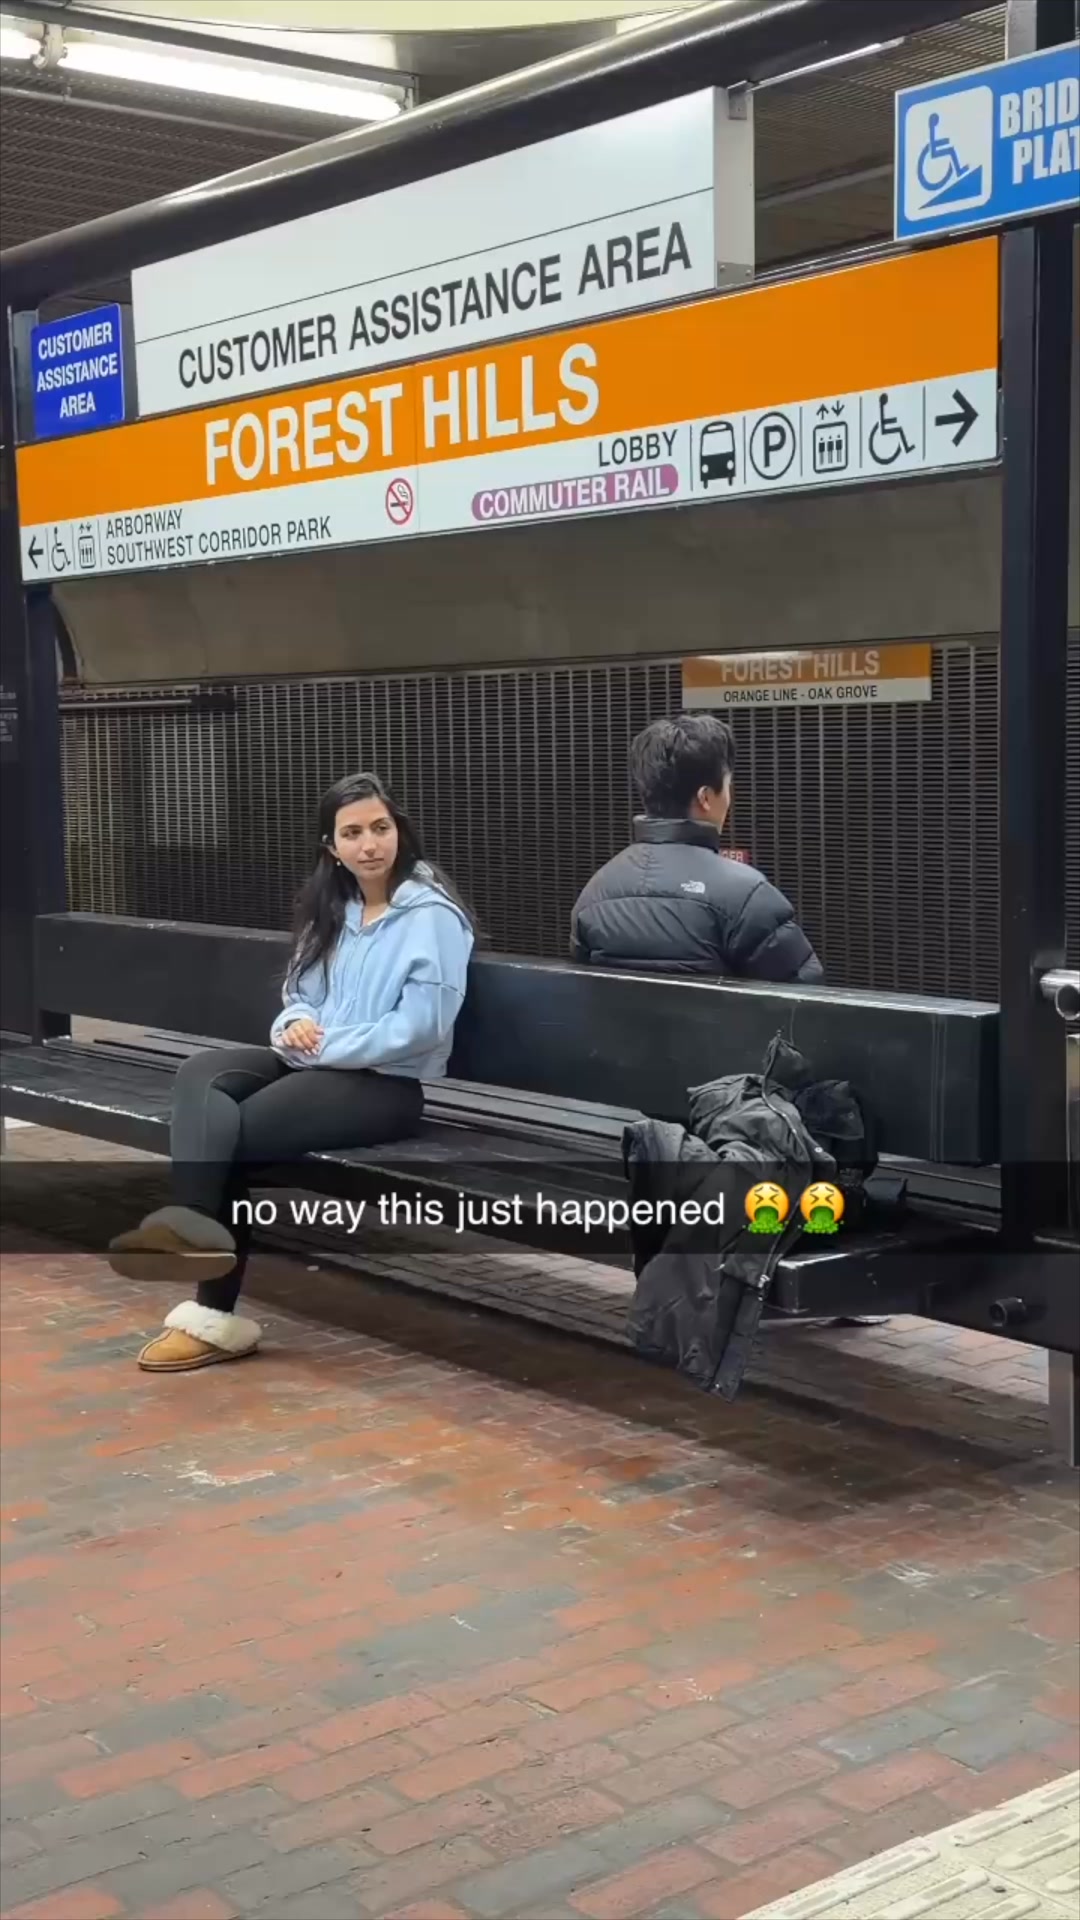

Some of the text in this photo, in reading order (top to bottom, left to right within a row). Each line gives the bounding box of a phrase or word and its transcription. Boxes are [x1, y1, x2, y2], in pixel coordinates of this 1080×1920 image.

[1000, 77, 1079, 139] BRID
[1012, 125, 1080, 185] PLAT
[178, 221, 692, 389] CUSTOMER ASSISTANCE AREA
[38, 321, 113, 361] CUSTOMER
[36, 353, 118, 392] ASSISTANCE
[59, 391, 96, 419] AREA
[204, 342, 600, 486] FOREST HILLS
[598, 429, 678, 468] LOBBY
[763, 423, 787, 469] P
[479, 467, 670, 519] COMMUTER RAIL
[105, 508, 183, 539] ARBORWAY
[107, 515, 332, 565] SOUTHWEST CORRIDOR PARK
[721, 650, 879, 682] FOREST HILLS
[723, 689, 770, 702] ORANGE
[772, 688, 798, 701] LINE
[807, 686, 833, 699] OAK
[836, 685, 878, 699] GROVE
